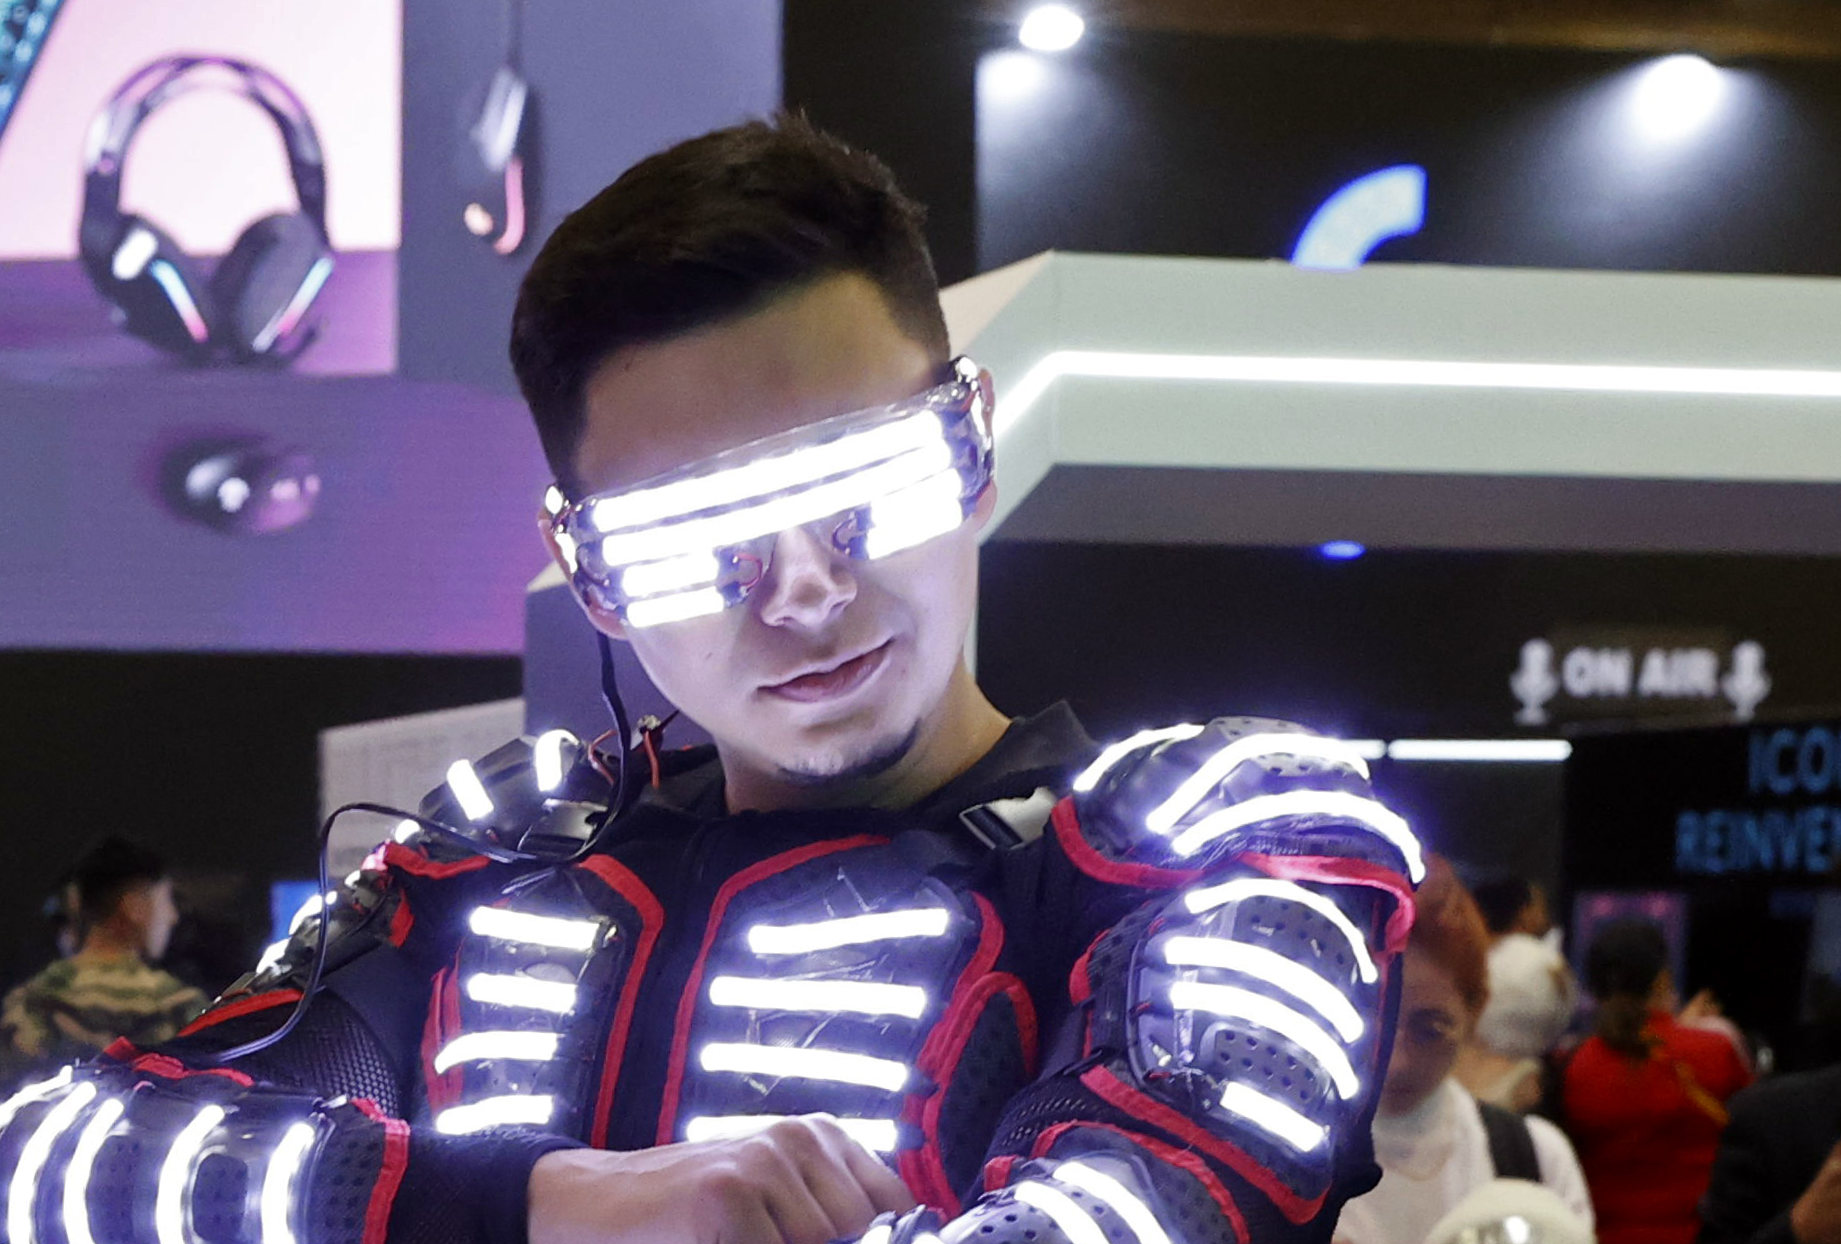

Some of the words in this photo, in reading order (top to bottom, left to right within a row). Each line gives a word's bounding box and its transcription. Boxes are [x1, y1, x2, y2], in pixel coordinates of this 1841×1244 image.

[1562, 647, 1630, 697] ON
[1637, 648, 1718, 697] AIR
[1749, 728, 1840, 793] ICO
[1676, 807, 1840, 872] REINVE
